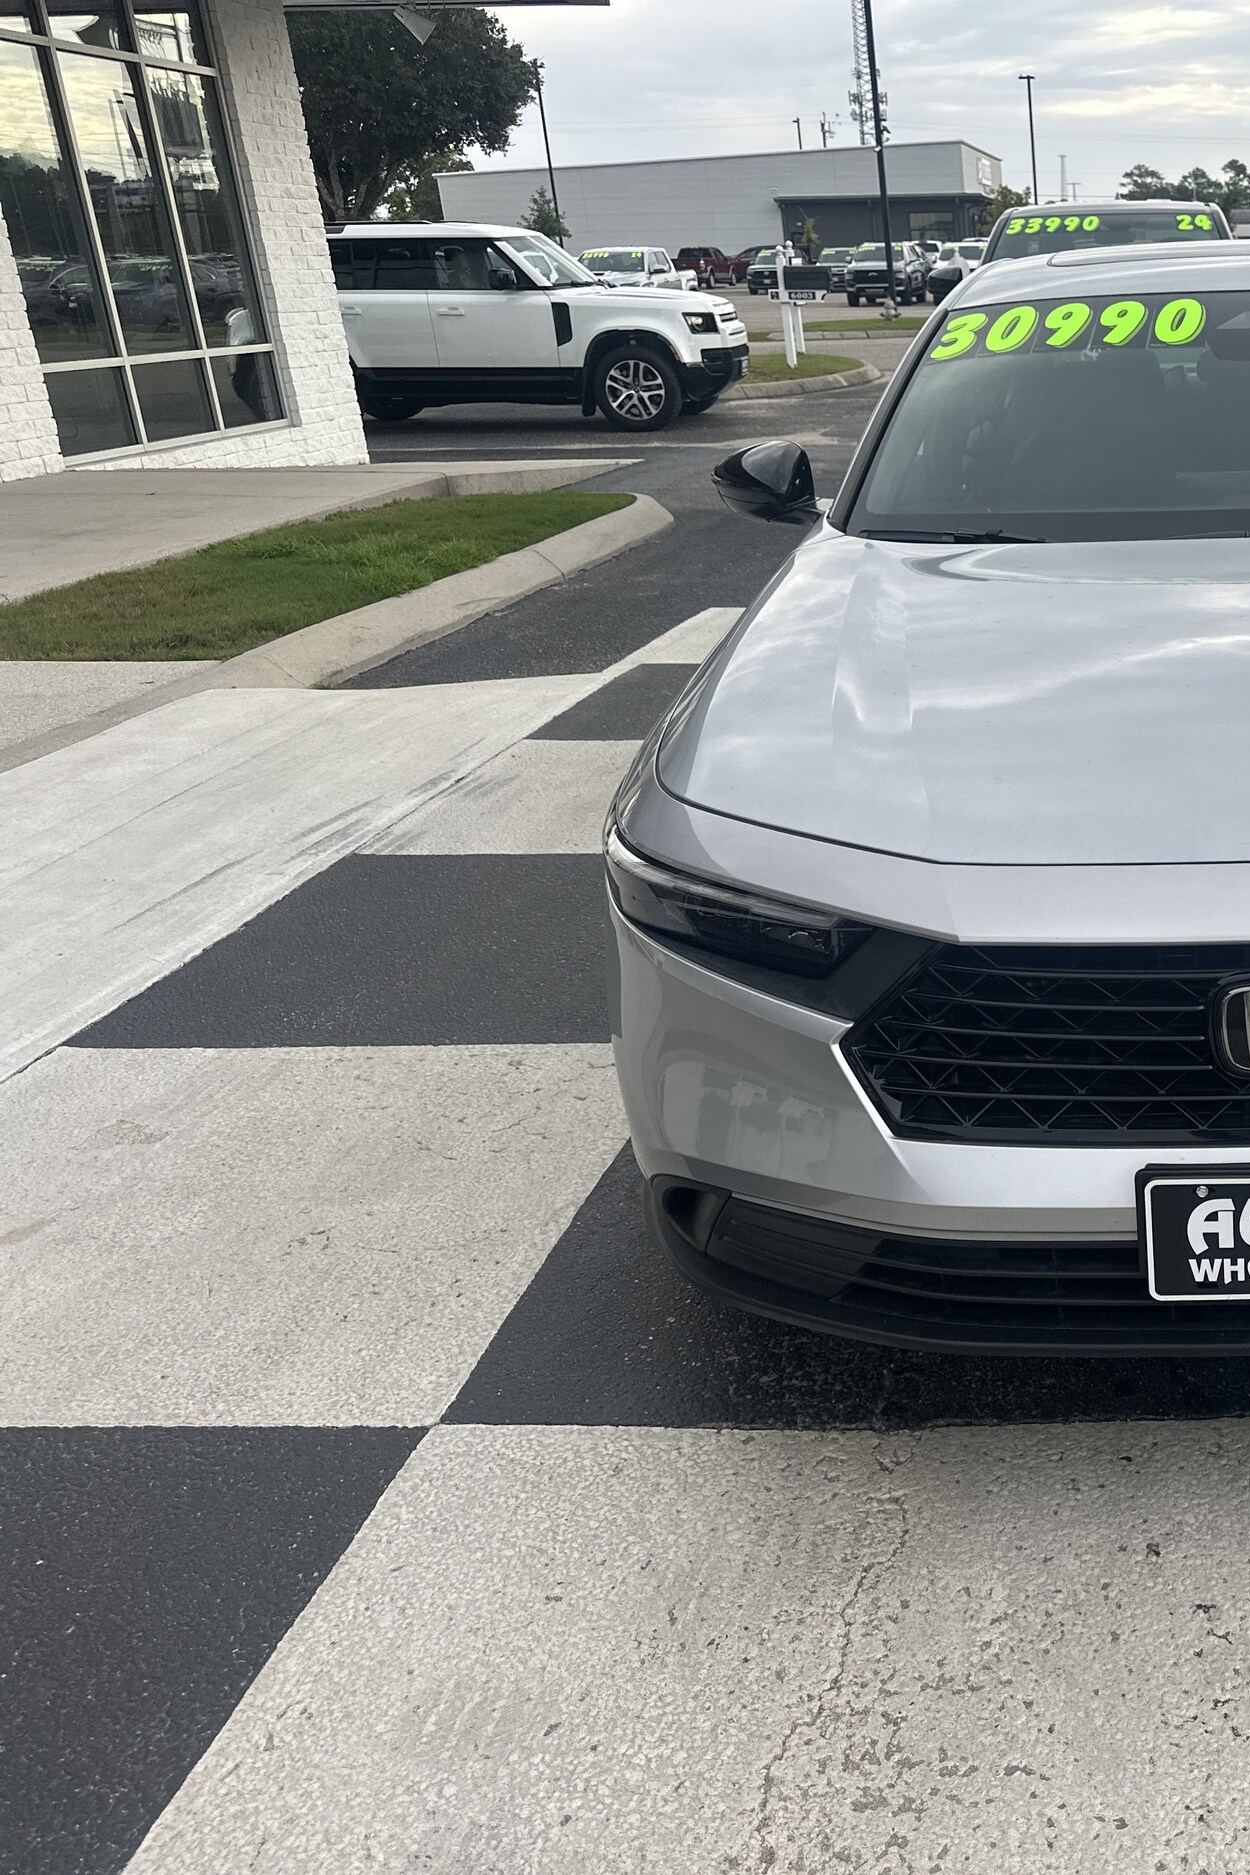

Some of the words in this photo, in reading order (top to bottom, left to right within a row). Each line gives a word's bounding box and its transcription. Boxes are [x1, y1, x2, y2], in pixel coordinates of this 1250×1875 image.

[1006, 215, 1100, 235] 33990
[1175, 214, 1213, 231] 24
[790, 292, 814, 300] 6003
[930, 298, 1206, 361] 30990
